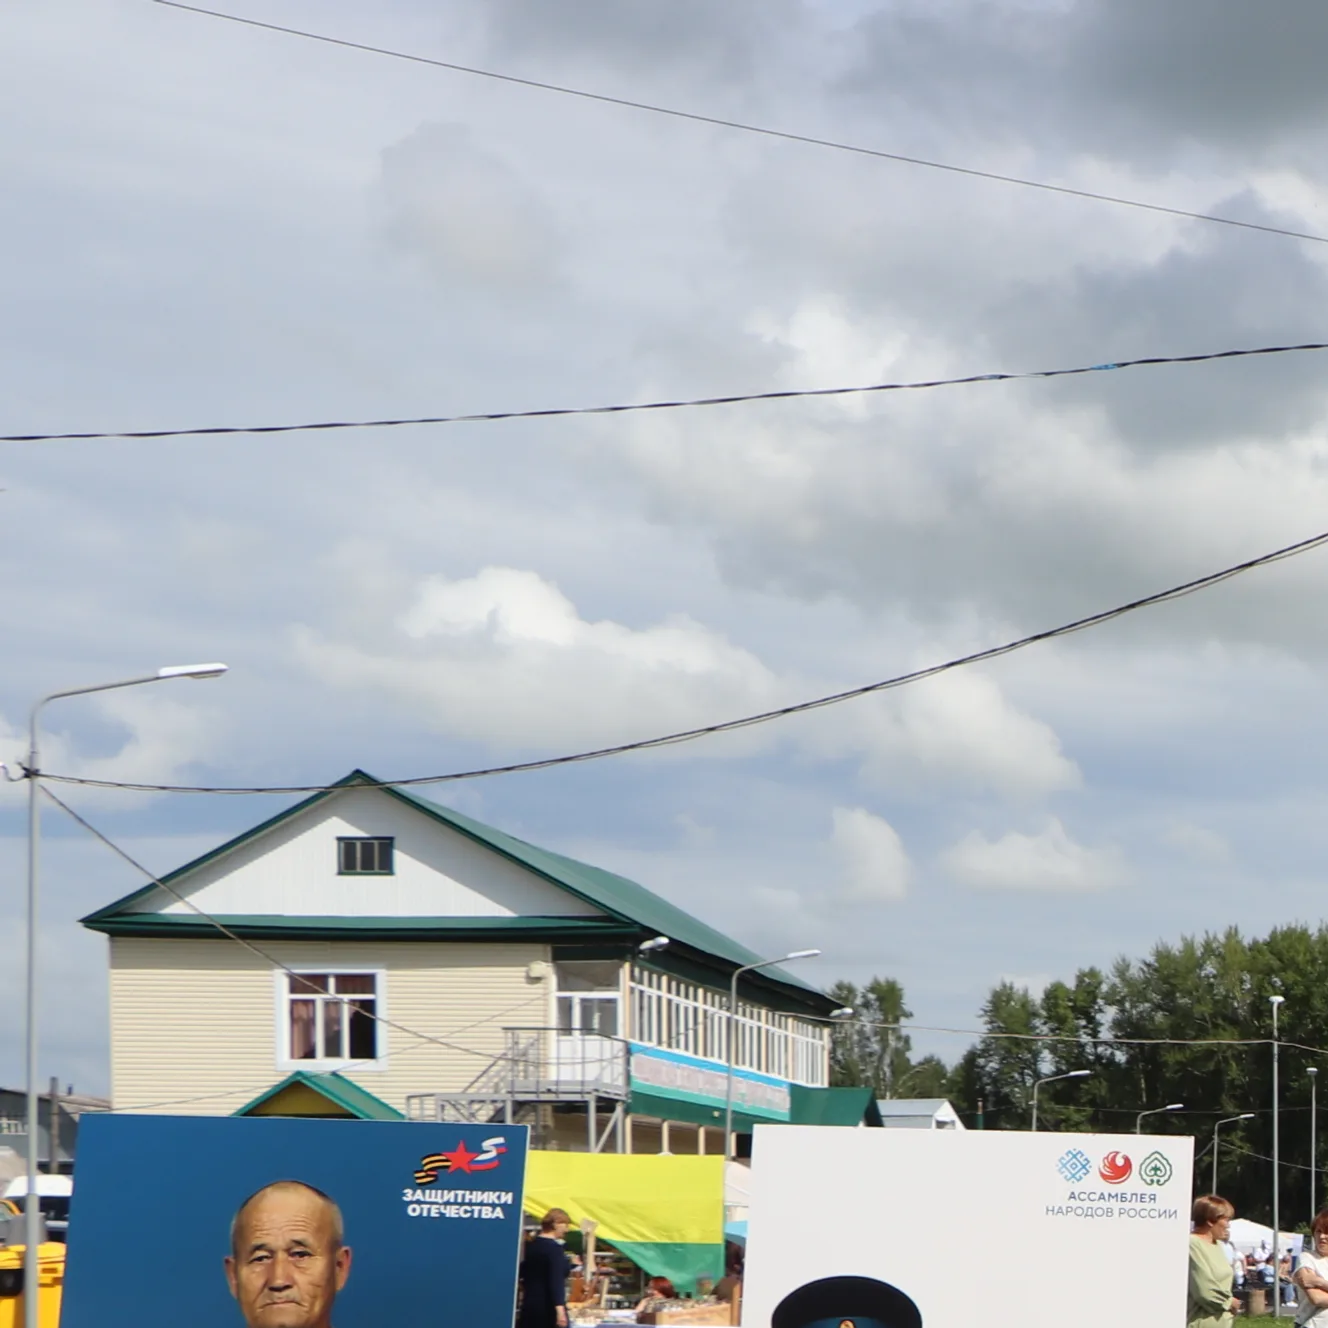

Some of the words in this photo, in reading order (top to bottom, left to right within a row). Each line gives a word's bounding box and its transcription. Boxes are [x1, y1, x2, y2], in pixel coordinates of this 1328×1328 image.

[402, 1188, 514, 1205] ЗАЩИТНИКИ
[1067, 1191, 1157, 1204] АССАМБЛЕЯ
[407, 1203, 505, 1220] ОТЕЧЕСТВА
[1045, 1205, 1114, 1219] НАРОДОВ
[1118, 1207, 1178, 1219] РОССИИ
